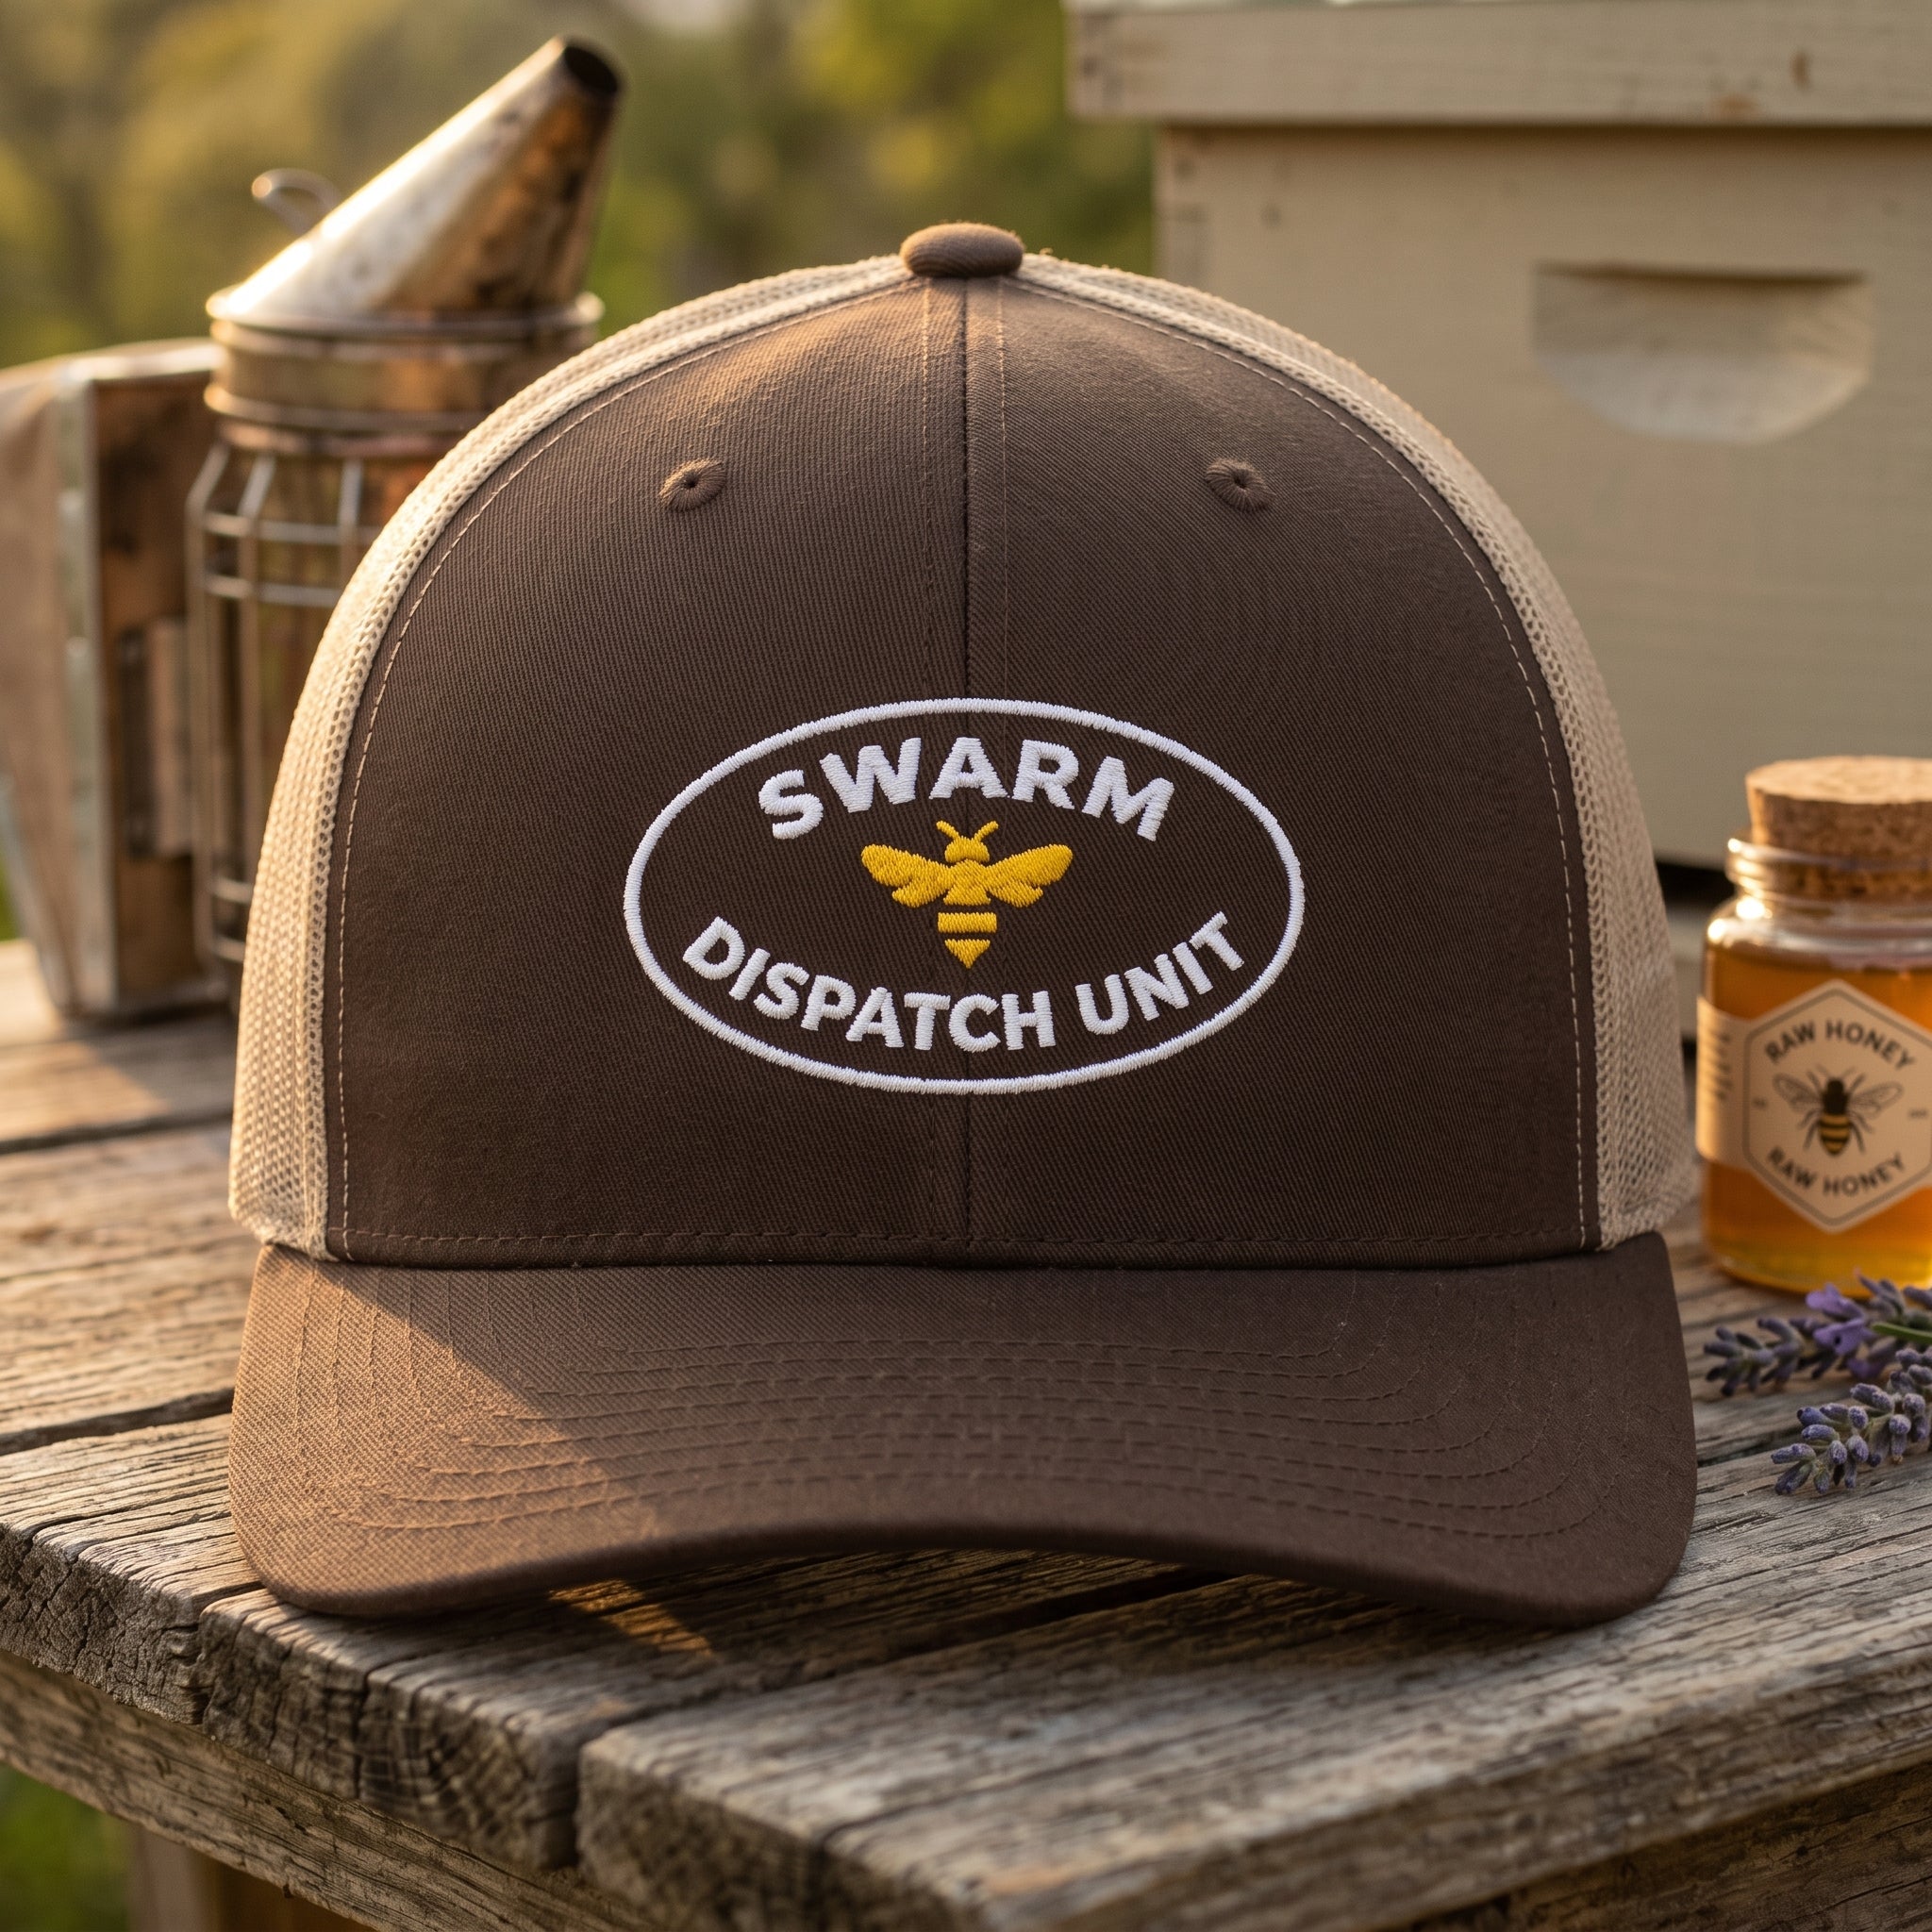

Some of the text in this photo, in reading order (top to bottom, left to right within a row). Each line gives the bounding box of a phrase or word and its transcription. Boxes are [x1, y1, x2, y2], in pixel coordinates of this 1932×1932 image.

[758, 737, 1174, 841] SWARM
[682, 911, 1244, 1052] DISPATCH UNIT
[1764, 1019, 1916, 1071] RAW HONEY
[1767, 1146, 1906, 1196] RAW HONEY
